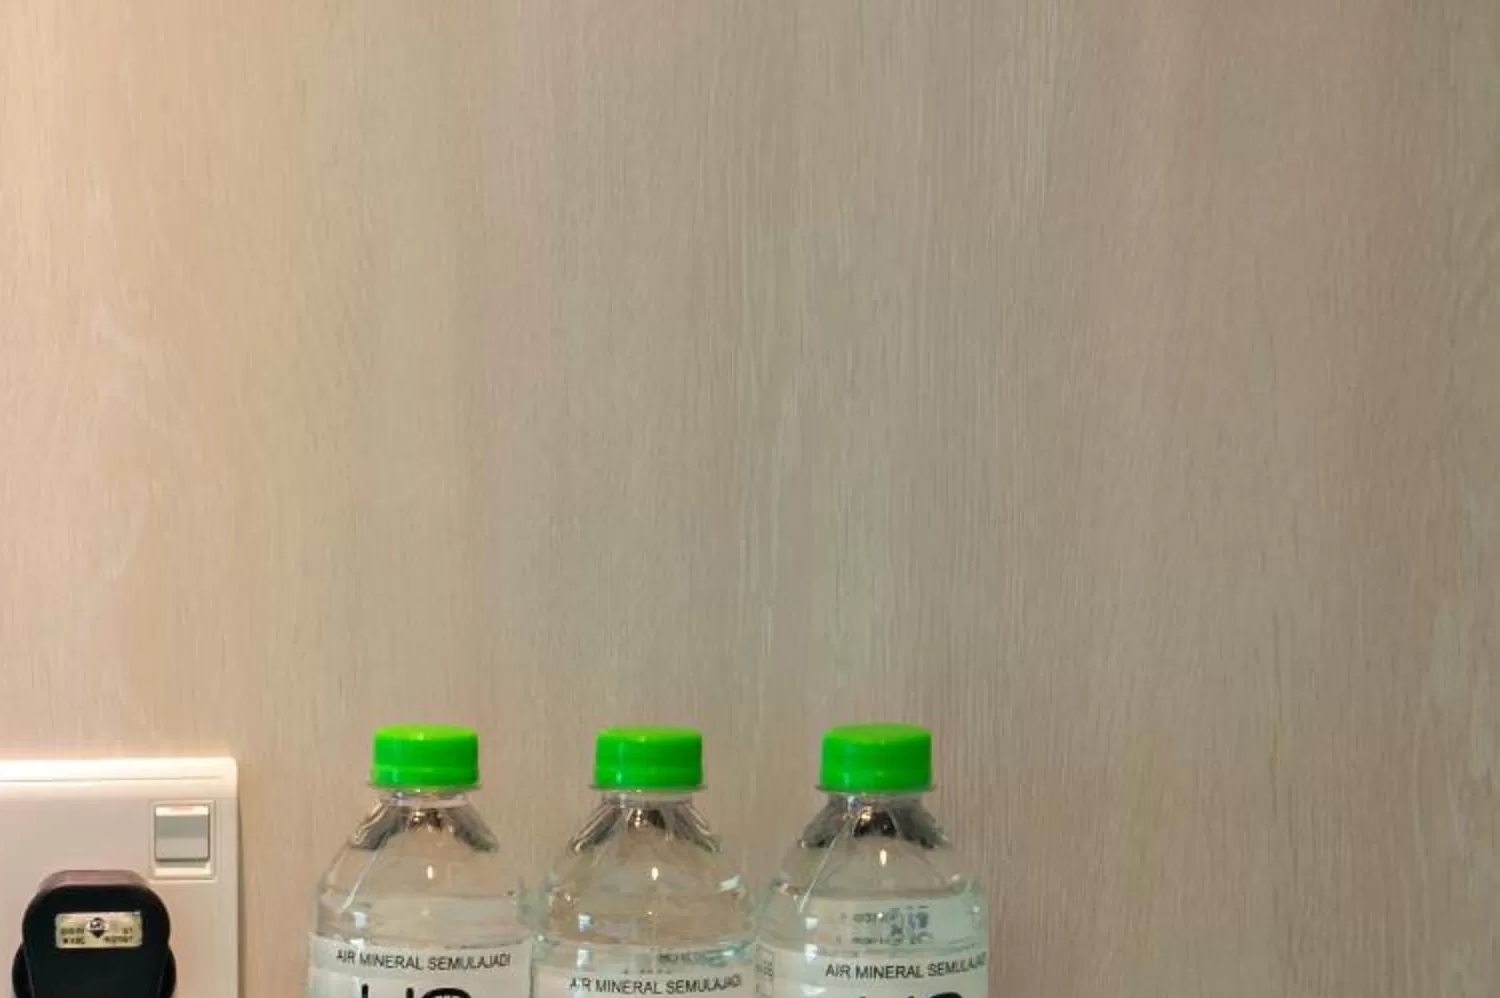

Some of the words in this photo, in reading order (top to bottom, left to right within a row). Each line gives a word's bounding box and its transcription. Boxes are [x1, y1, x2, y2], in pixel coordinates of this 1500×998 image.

[359, 951, 424, 970] MINERAL
[427, 952, 512, 971] SEMULAJADI
[825, 963, 852, 978] AIR
[855, 964, 924, 980] MINERAL
[595, 978, 663, 995] MINERAL
